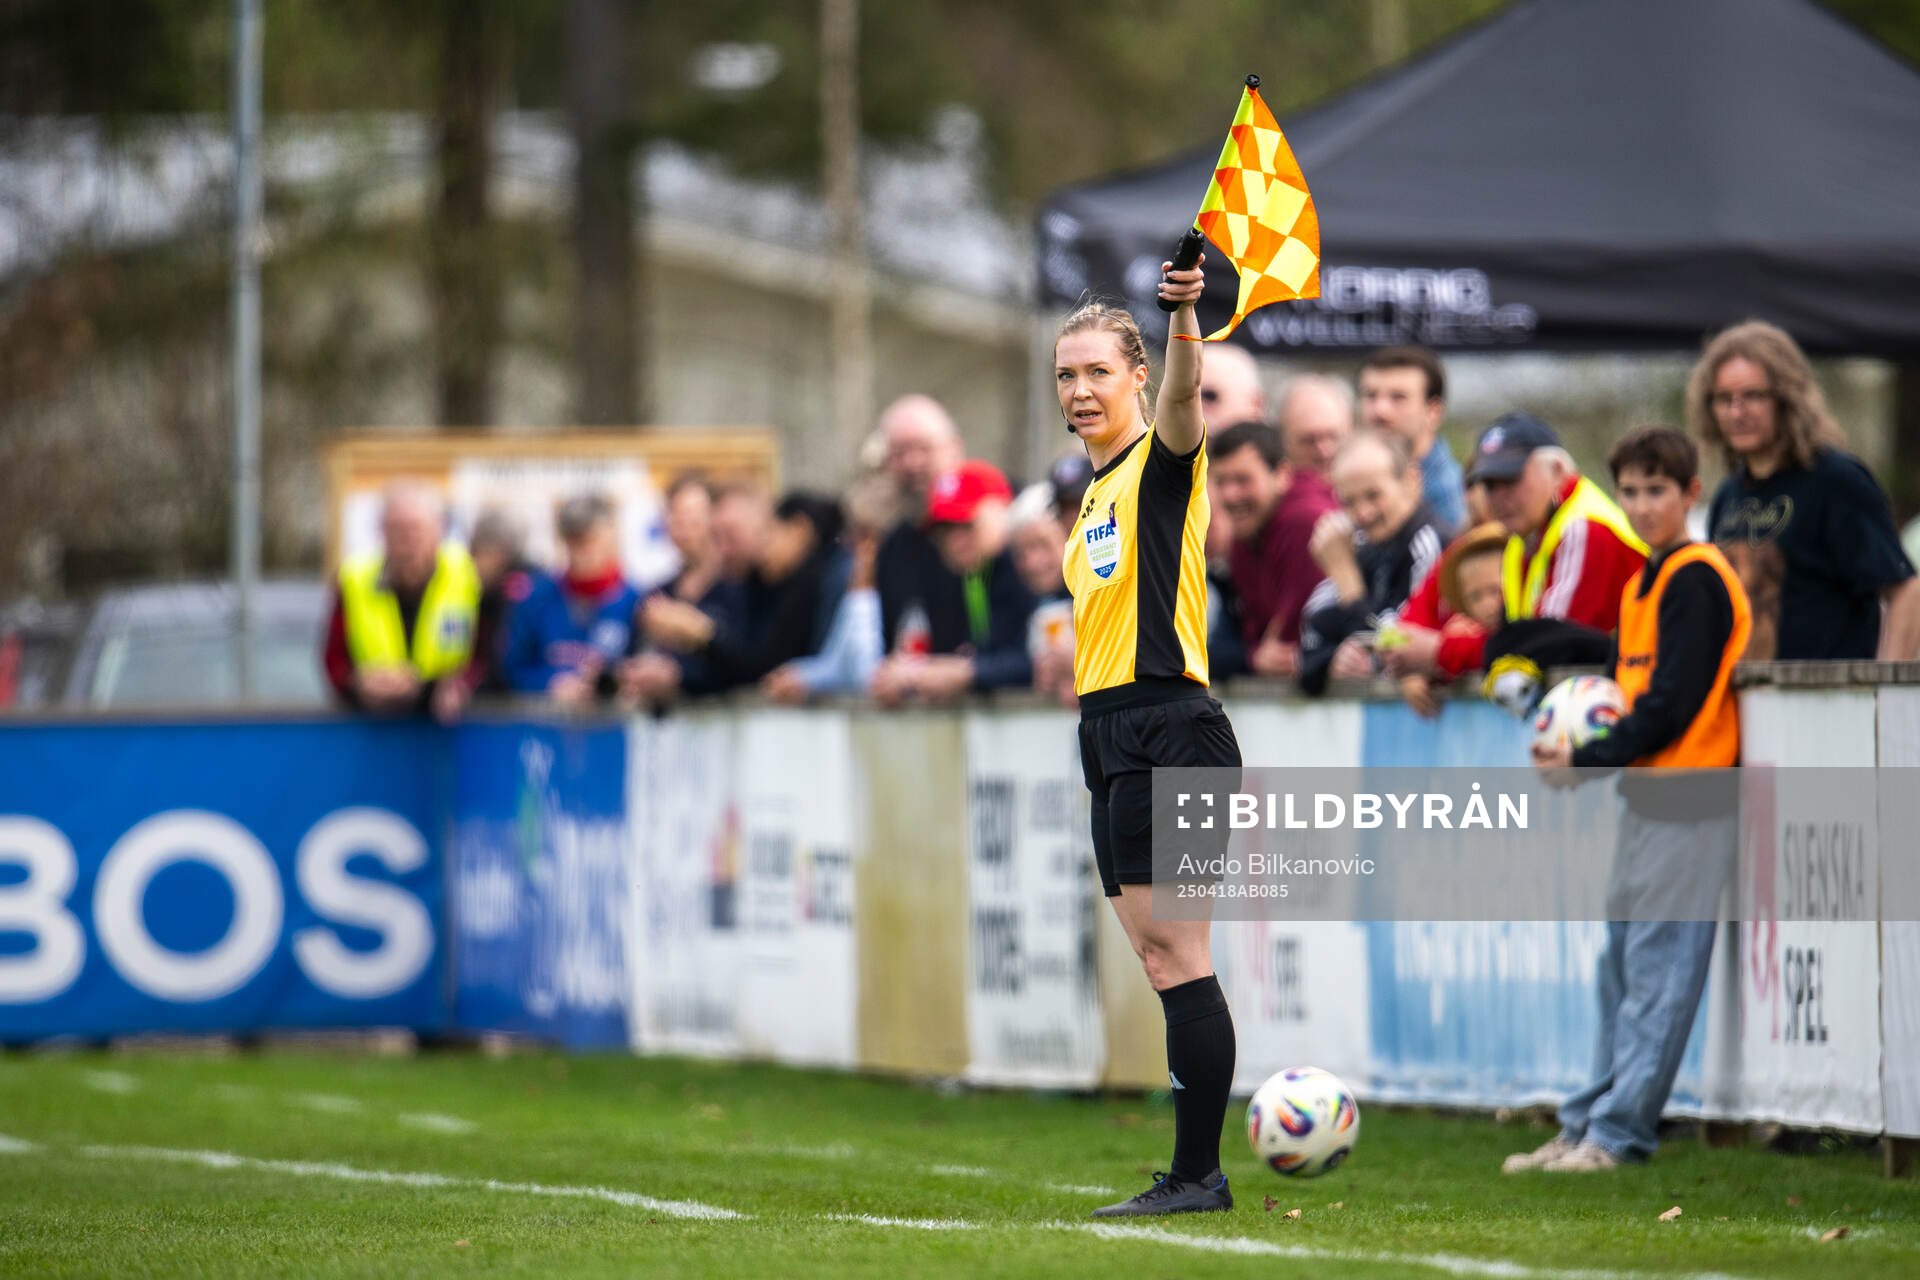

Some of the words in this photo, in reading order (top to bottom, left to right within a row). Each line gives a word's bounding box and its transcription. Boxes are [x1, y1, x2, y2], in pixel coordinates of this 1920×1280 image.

[1086, 523, 1115, 544] FIFA
[1099, 565, 1112, 576] 2025
[0, 806, 435, 1003] BOS
[1783, 821, 1865, 922] SVENSKA
[1784, 945, 1828, 1044] SPEL
